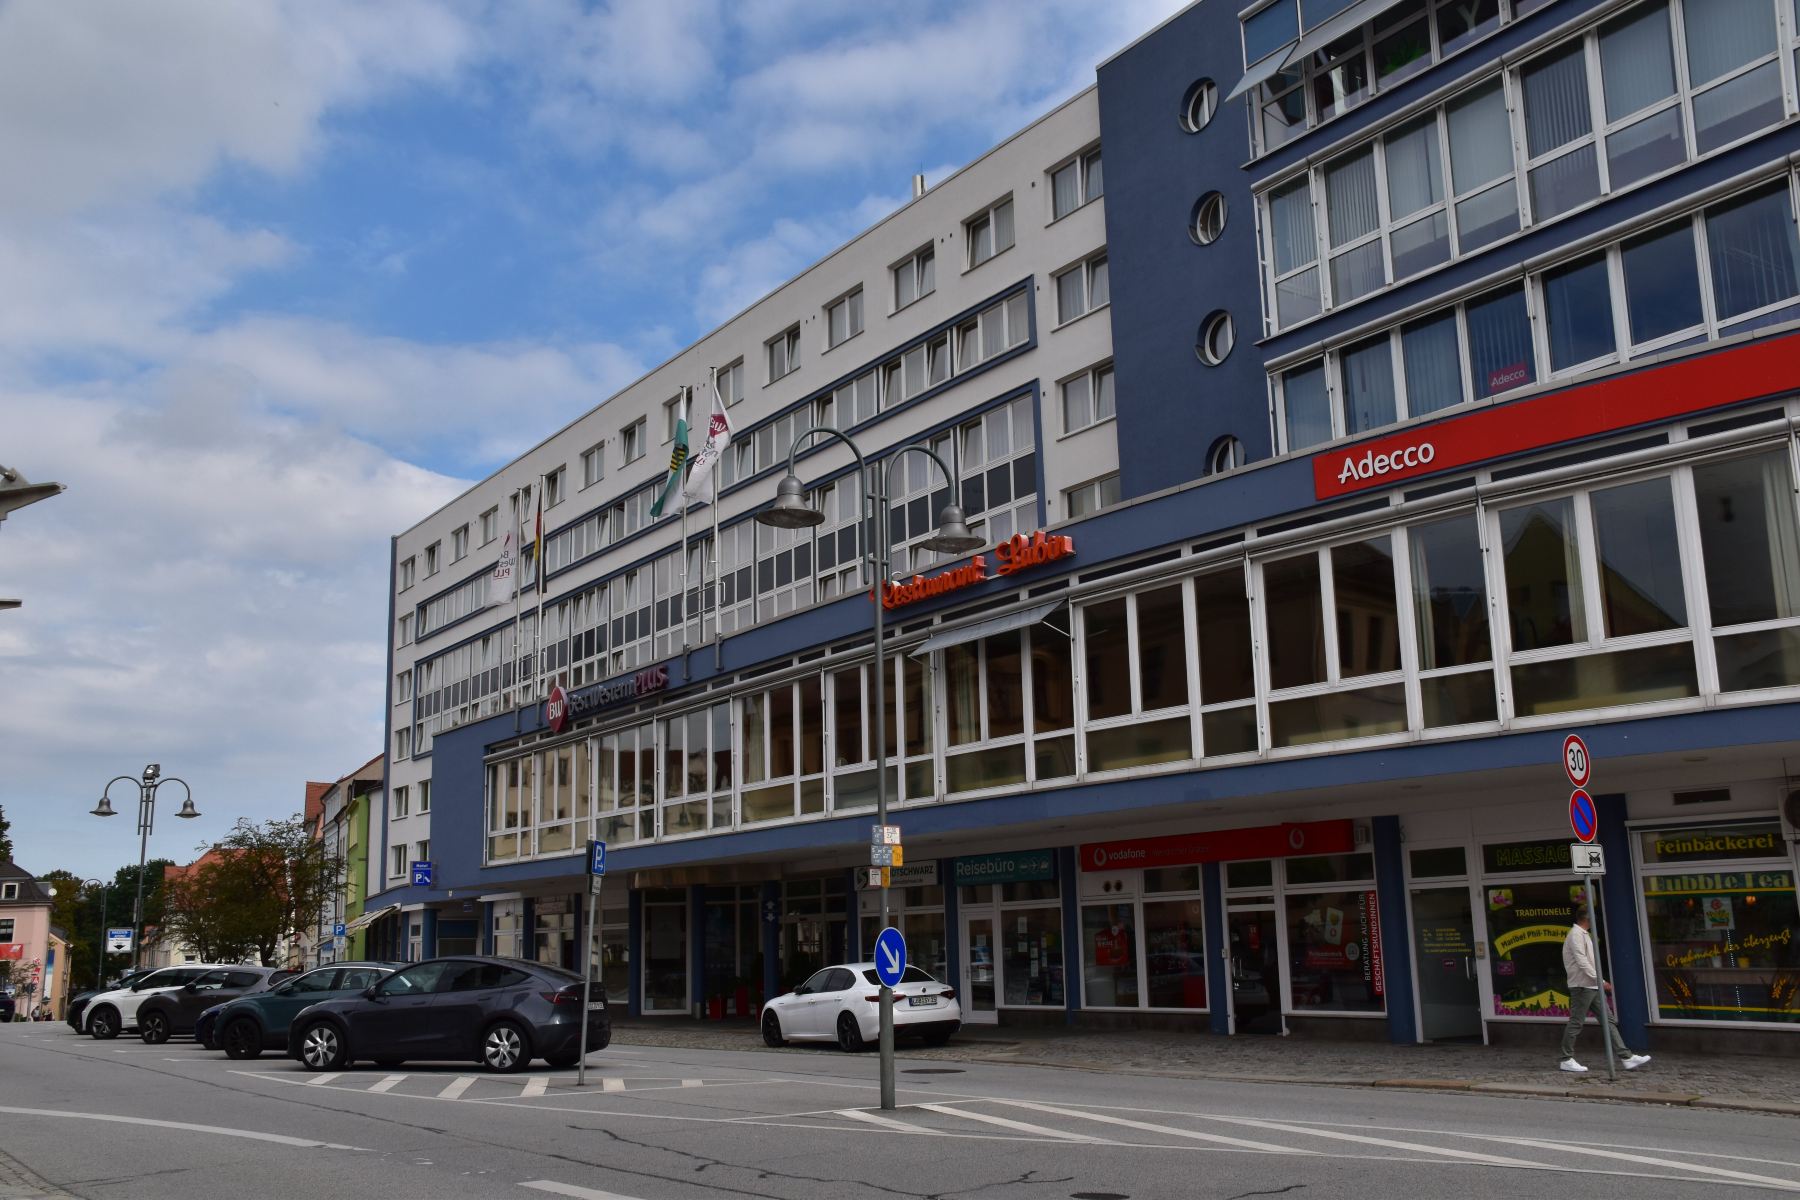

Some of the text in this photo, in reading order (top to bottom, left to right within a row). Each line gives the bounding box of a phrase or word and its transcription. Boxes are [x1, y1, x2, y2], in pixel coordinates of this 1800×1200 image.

[1491, 369, 1526, 387] Adecco
[1337, 443, 1435, 484] Adecco
[548, 700, 564, 721] BW
[1568, 748, 1585, 772] 30
[1655, 832, 1775, 855] Feinbäckerei
[594, 844, 603, 870] P
[1108, 848, 1146, 861] vodafone
[1496, 844, 1570, 866] MASSAG
[415, 873, 423, 883] P
[956, 859, 1015, 876] Reisebüro
[1515, 906, 1572, 918] TRADITIONELLE
[335, 925, 343, 935] P
[1358, 893, 1372, 982] BERATUNG AUCH FÜR
[1501, 928, 1568, 949] Maribel Phil-Thai-M
[1369, 893, 1383, 992] GESCHÄFTSKUND:INNEN
